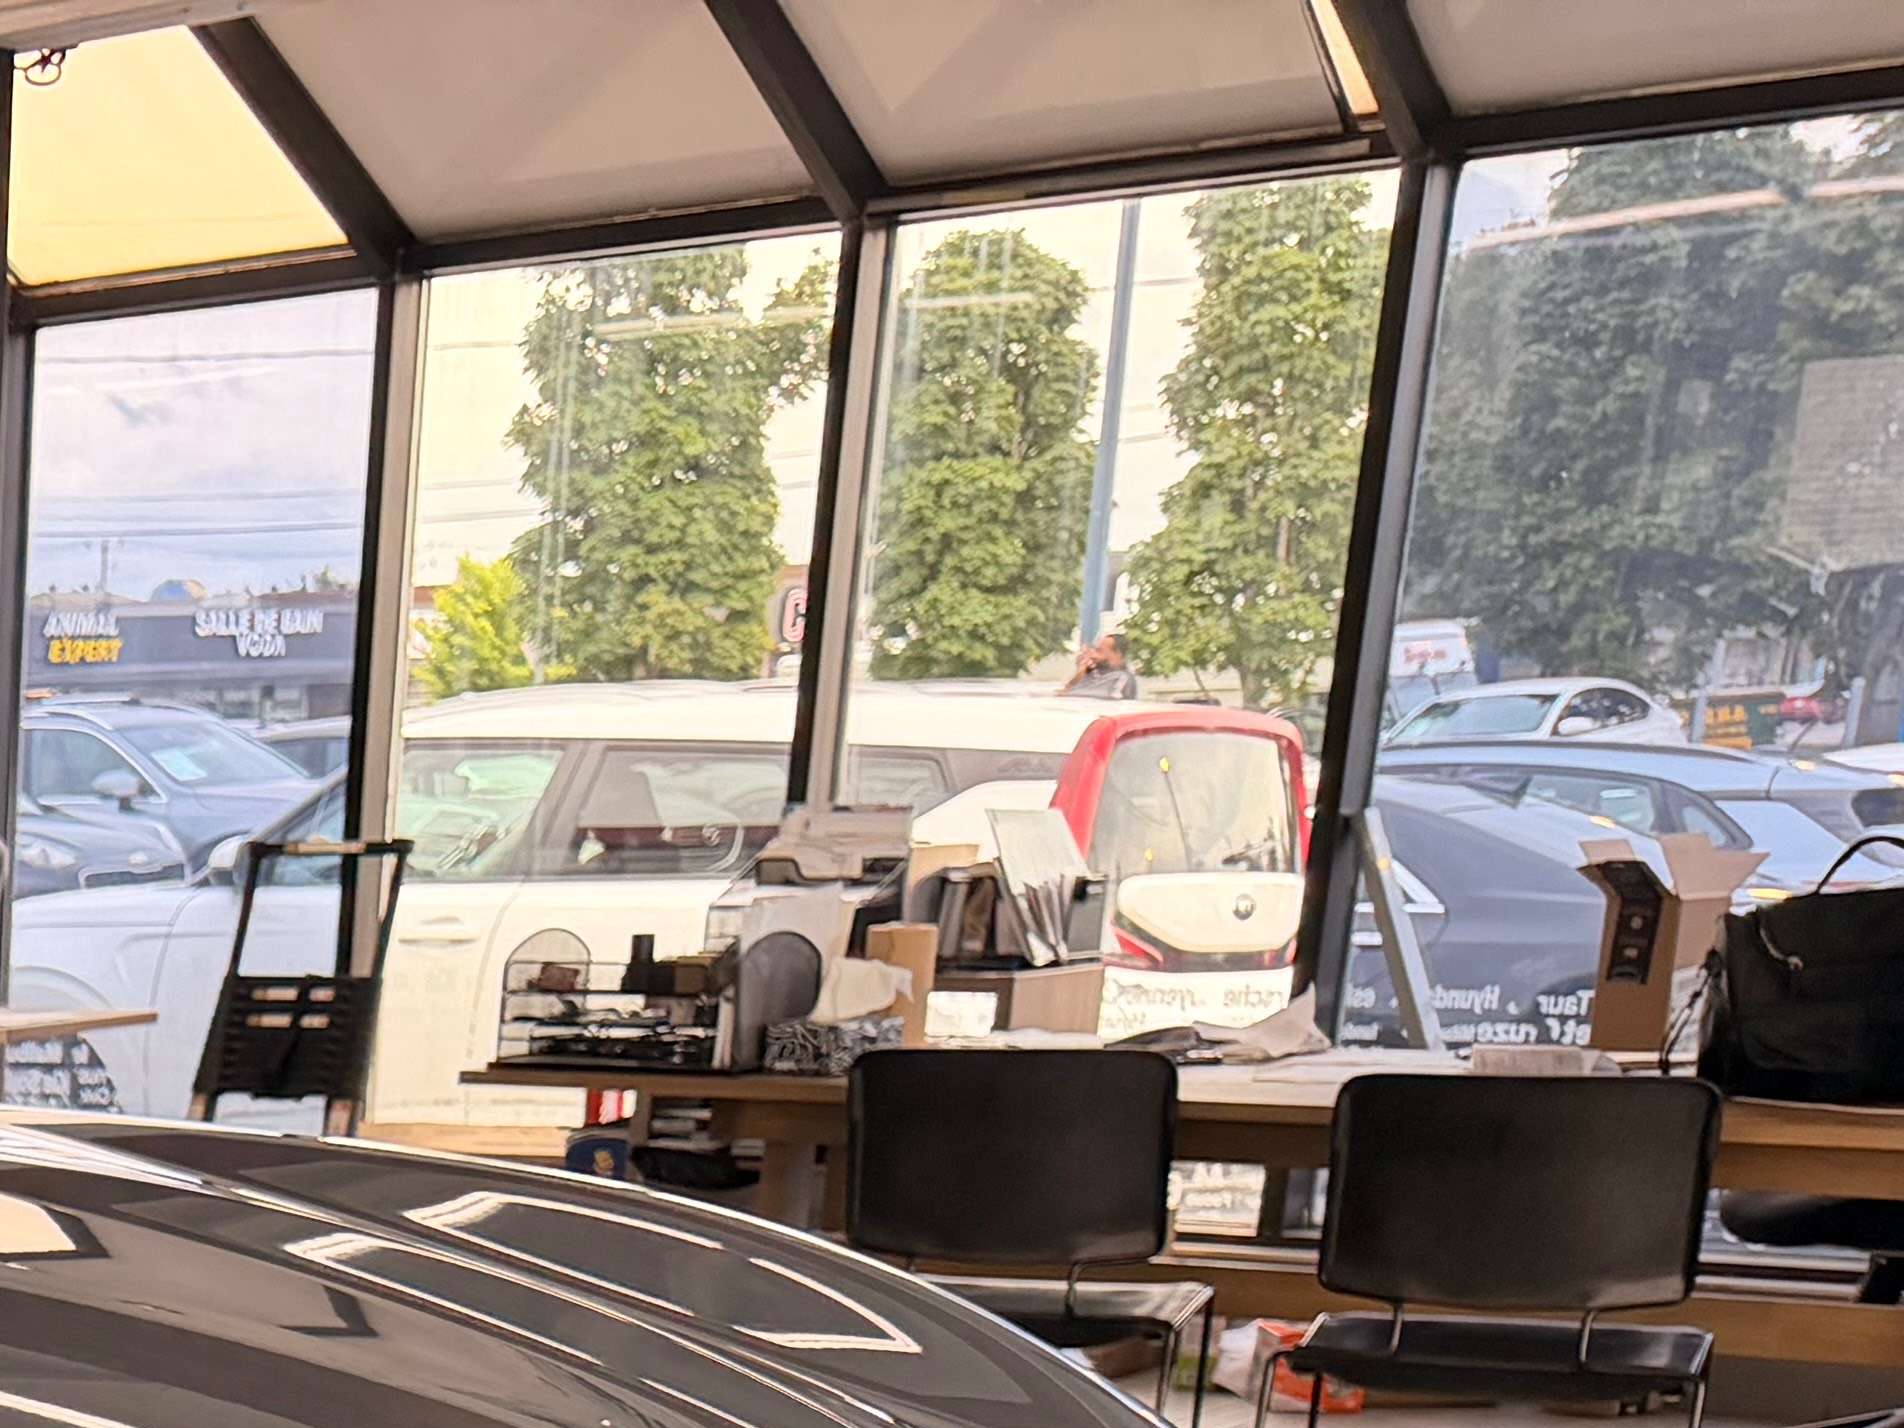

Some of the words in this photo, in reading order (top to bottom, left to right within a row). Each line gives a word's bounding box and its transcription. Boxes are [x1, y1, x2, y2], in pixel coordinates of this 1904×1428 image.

[43, 610, 119, 637] ANIMAL
[194, 609, 251, 637] SALLE
[48, 637, 123, 665] EXPERT
